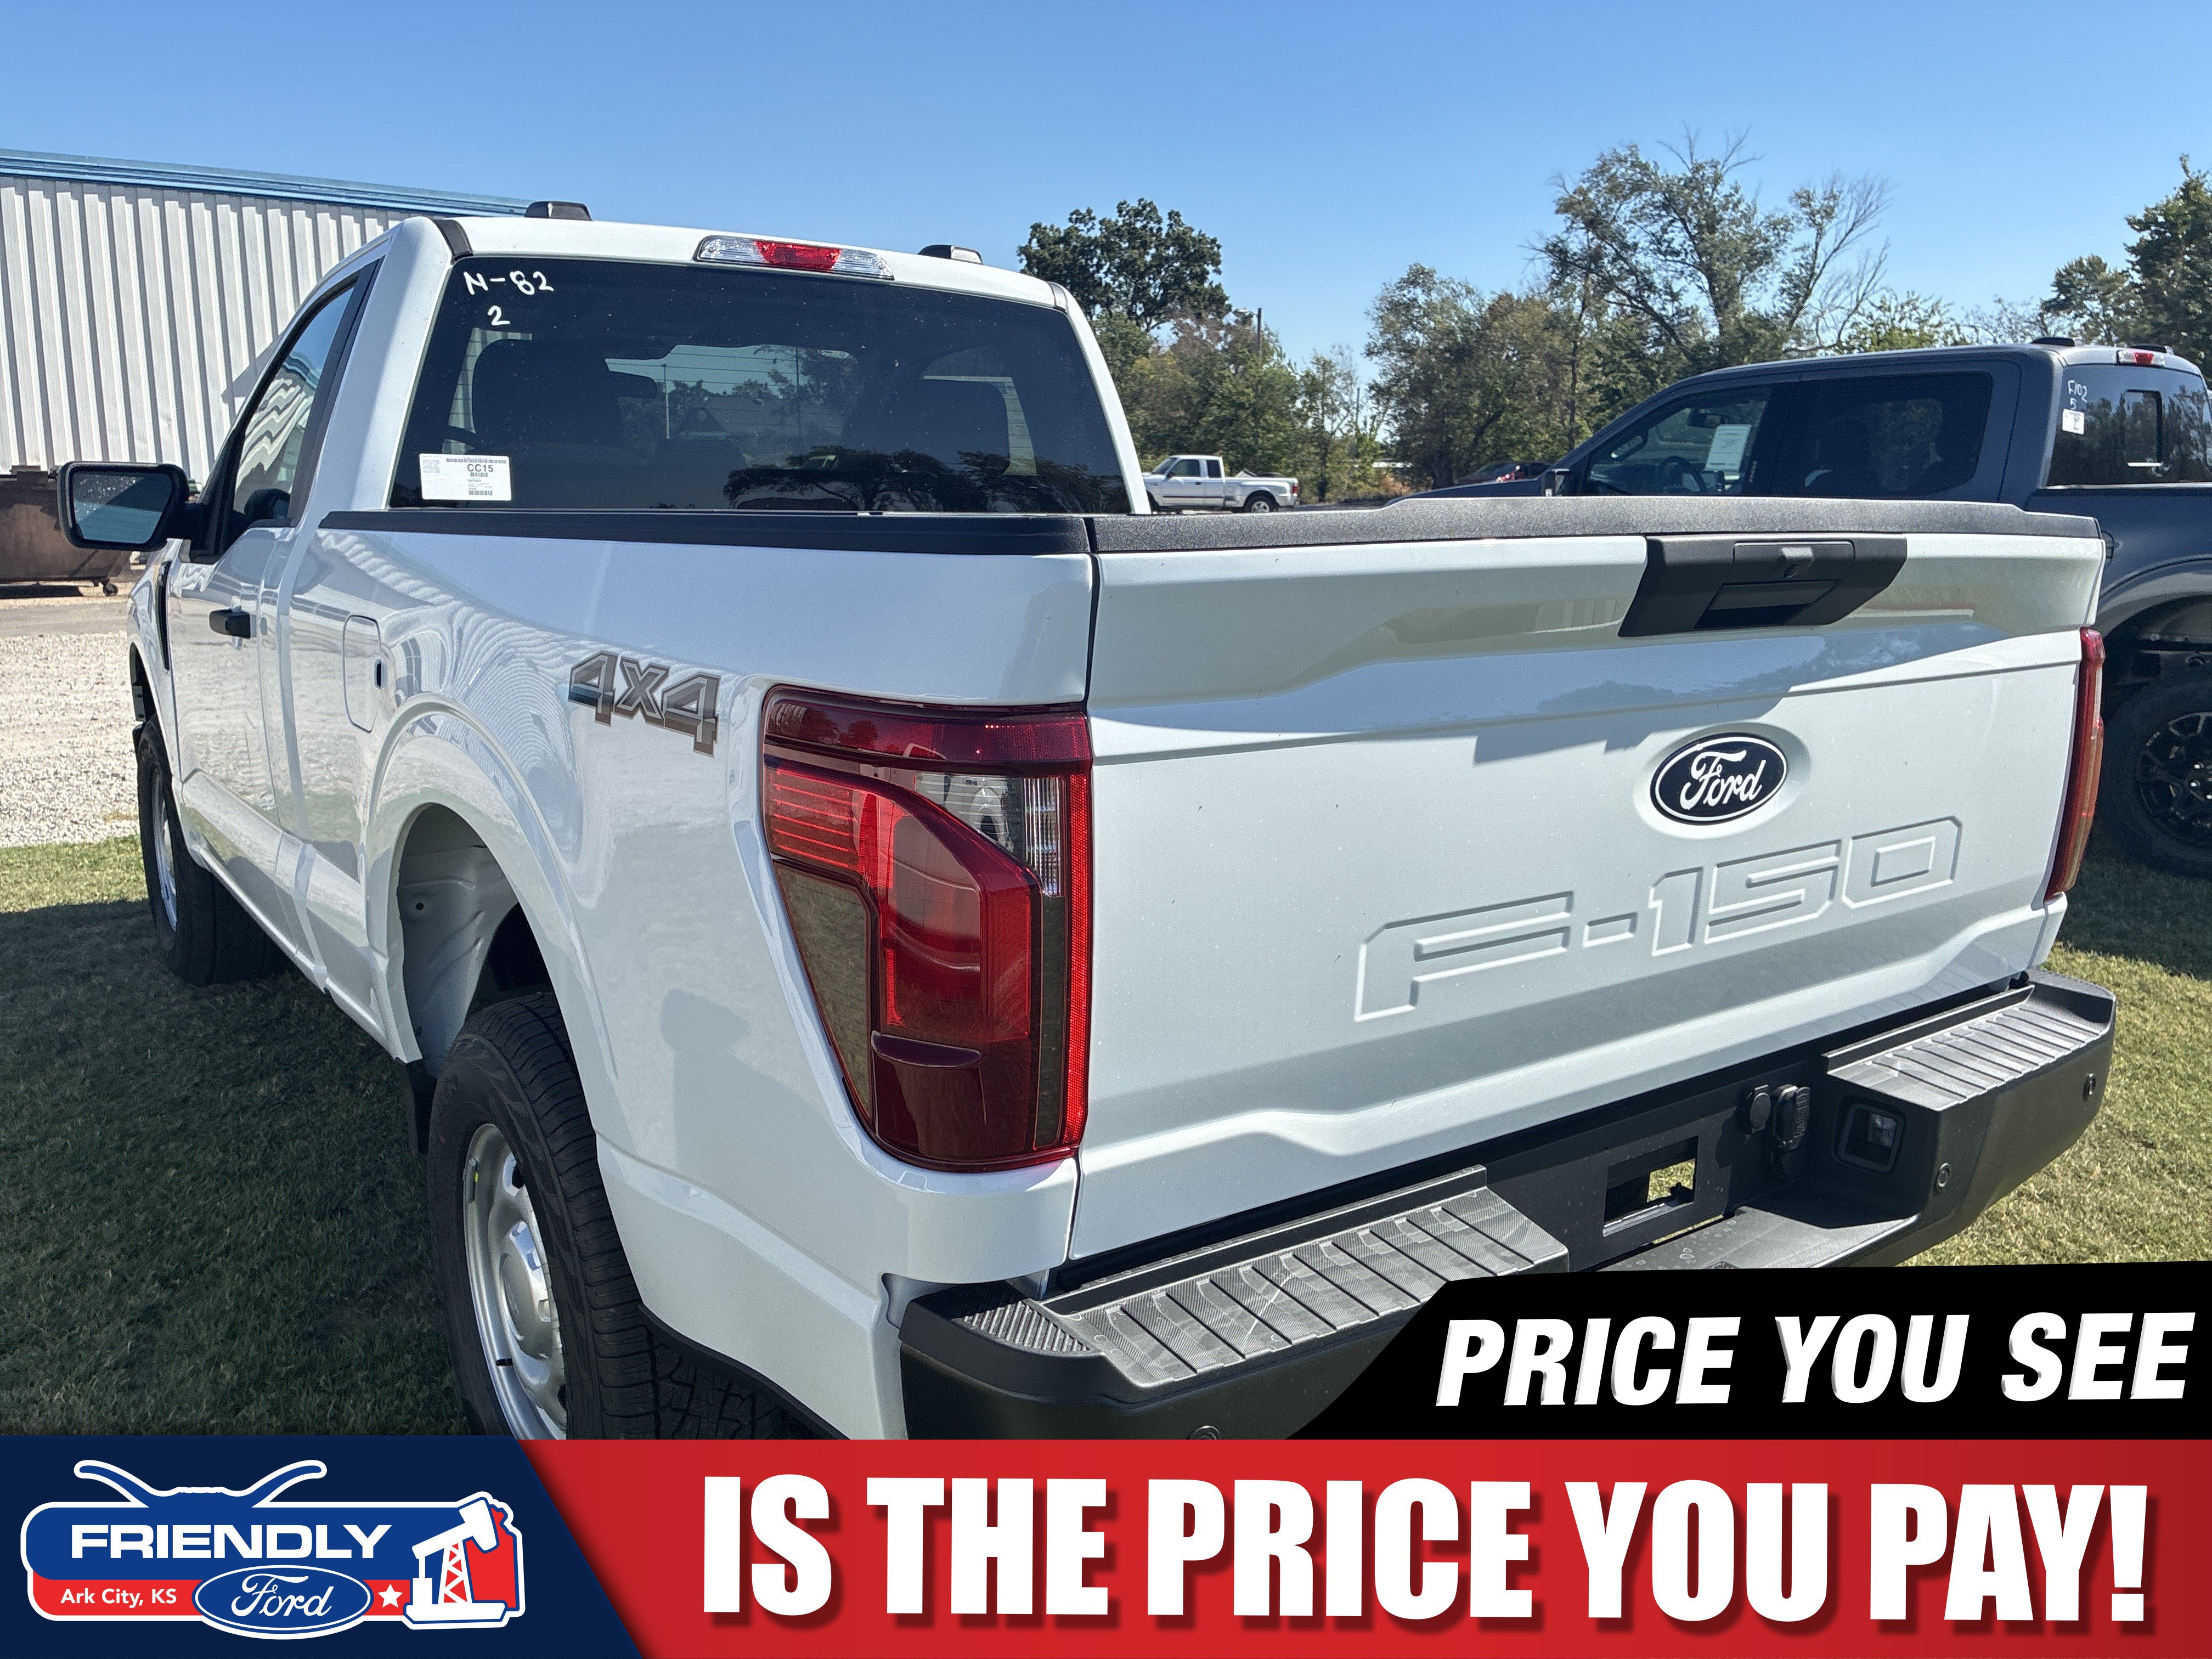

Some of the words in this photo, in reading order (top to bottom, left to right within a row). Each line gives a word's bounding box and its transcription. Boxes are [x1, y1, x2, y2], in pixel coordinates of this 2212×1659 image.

[464, 271, 554, 295] N-82
[488, 305, 511, 326] 2
[467, 464, 494, 472] CC15
[1680, 749, 1767, 810] Ford
[1354, 816, 1962, 1022] F-150
